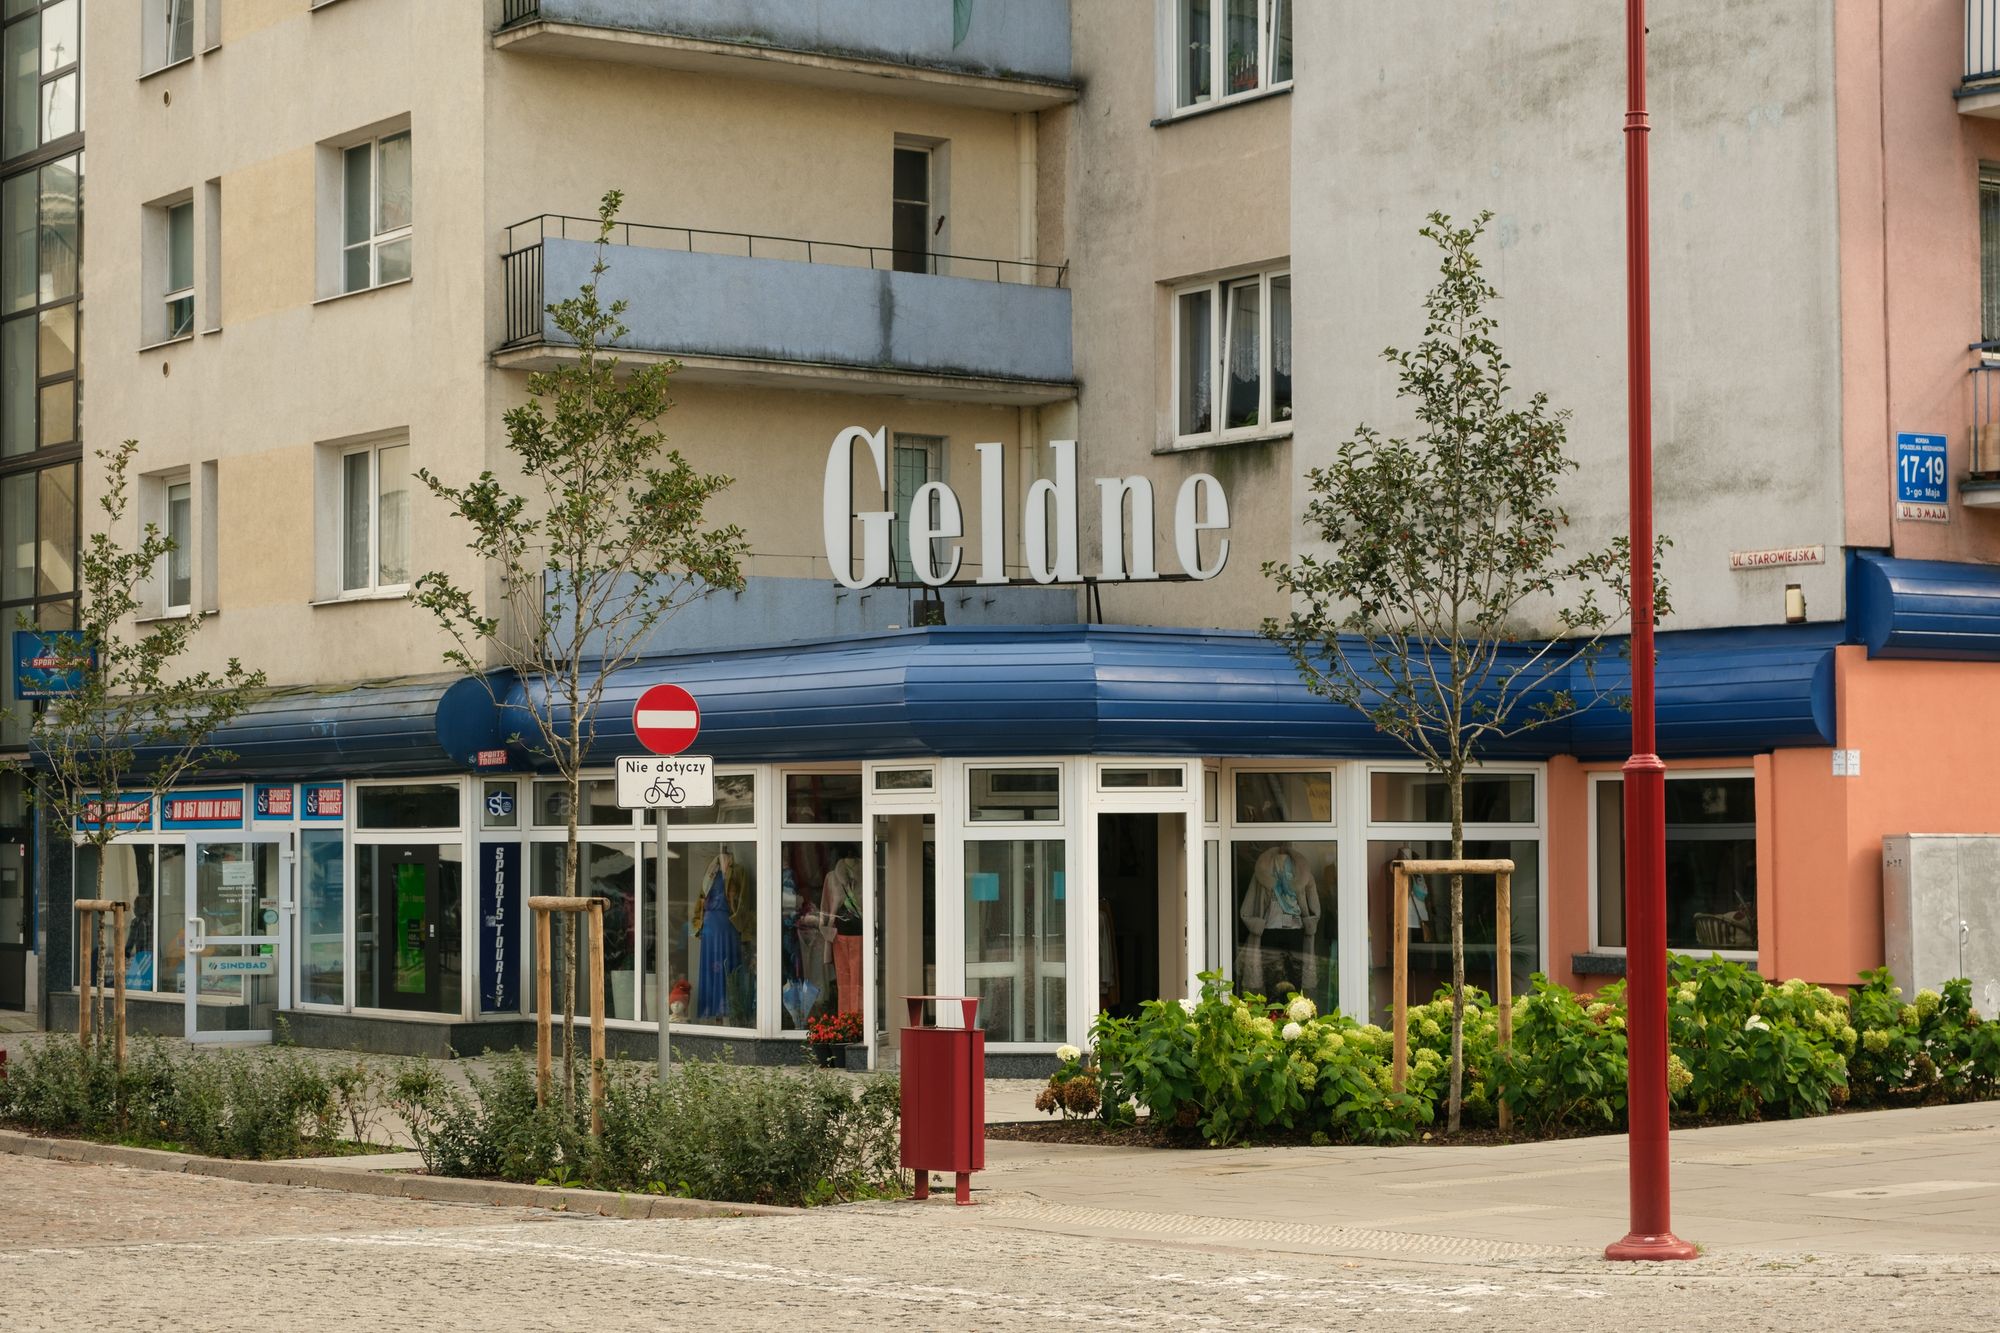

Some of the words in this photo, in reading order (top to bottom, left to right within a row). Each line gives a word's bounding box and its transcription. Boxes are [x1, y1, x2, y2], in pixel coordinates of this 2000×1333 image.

[1901, 455, 1945, 485] 17-19
[1905, 486, 1922, 498] 3-go
[1925, 487, 1941, 499] Maja
[823, 425, 1231, 590] Geldne
[1917, 507, 1922, 518] 3
[1924, 509, 1947, 520] MAJA
[1733, 553, 1745, 566] UL.
[1748, 549, 1817, 565] STAROWIEJSKA
[626, 761, 648, 773] Nie
[656, 760, 706, 776] dotyczy
[269, 801, 292, 813] TOURIST
[319, 801, 342, 814] TOURIST
[495, 847, 504, 920] SPORTS
